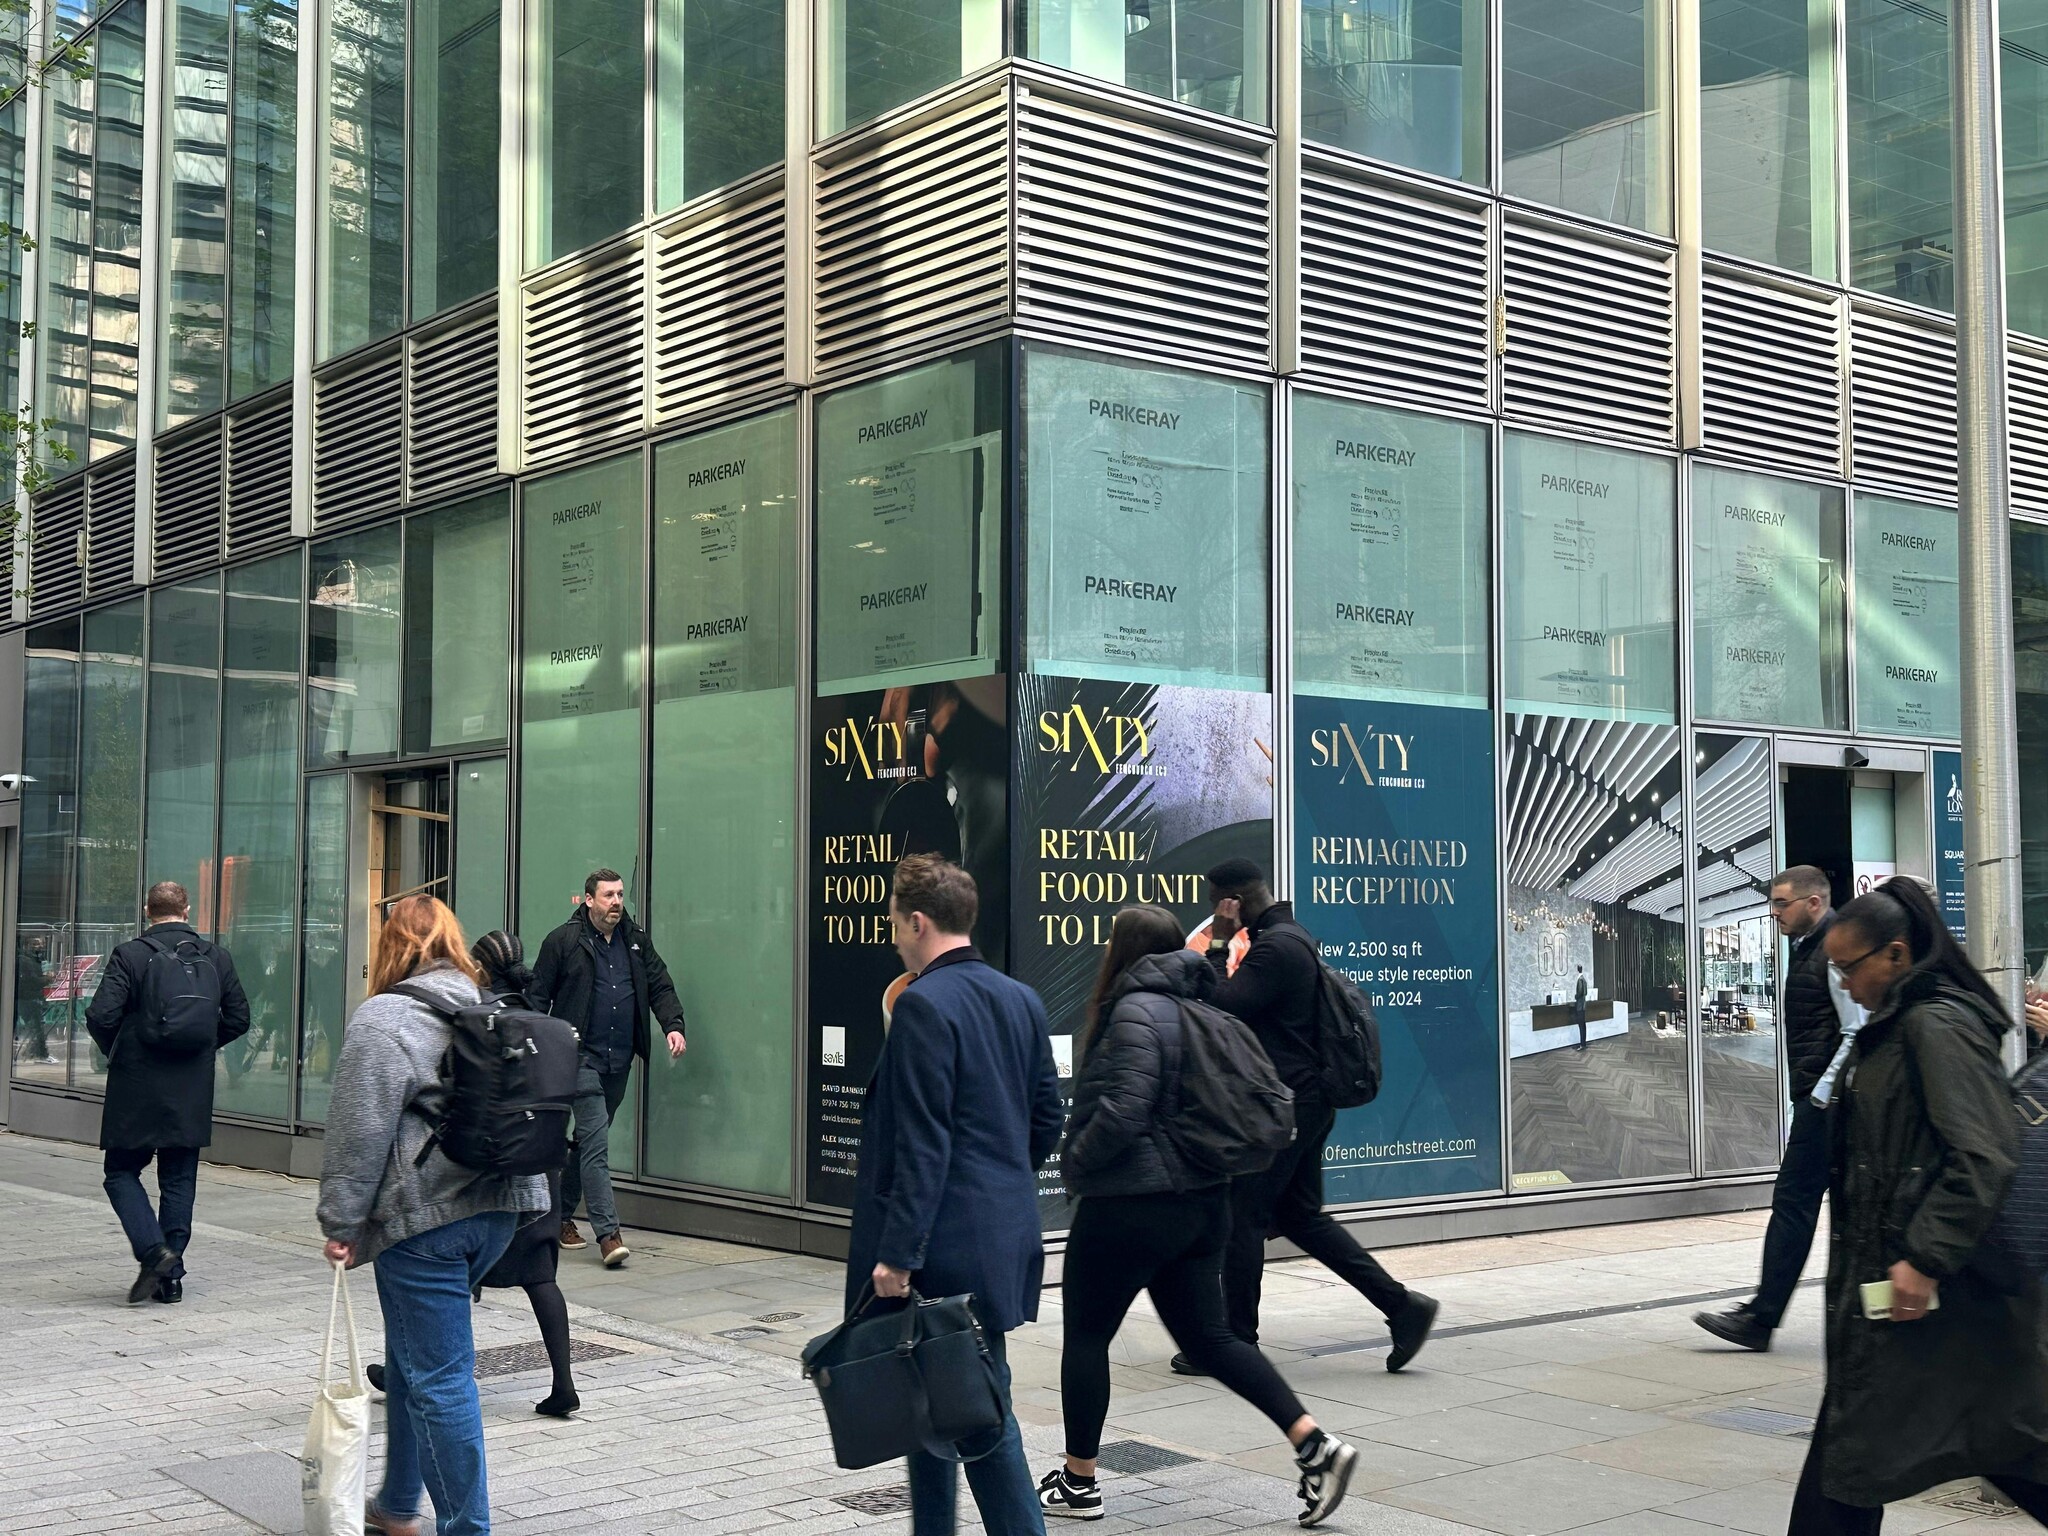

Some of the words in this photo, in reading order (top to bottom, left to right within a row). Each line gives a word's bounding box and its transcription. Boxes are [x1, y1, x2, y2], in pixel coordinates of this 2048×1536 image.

[858, 410, 928, 444] PARKERAY
[1089, 399, 1180, 430] PARKERAY
[1336, 440, 1416, 467] PARKERAY
[688, 459, 746, 488] PARKERAY
[1541, 474, 1609, 499] PARKERAY
[552, 501, 602, 525] PARKERAY
[1724, 505, 1786, 527] PARKERAY
[1882, 532, 1936, 551] PARKERAY
[860, 583, 928, 611] PARKERAY
[1085, 576, 1178, 603] PARKERAY
[687, 616, 749, 640] PARKERAY
[1336, 602, 1415, 627] PARKERAY
[1543, 625, 1607, 647] PARKERAY
[550, 644, 603, 665] PARKERAY
[1726, 646, 1786, 666] PARKERAY
[1886, 666, 1938, 683] PARKERAY
[824, 716, 908, 781] SIXTY
[1039, 704, 1155, 774] SIXTY
[1311, 722, 1414, 786] SIXTY
[1312, 836, 1467, 867] REIMAGINED
[825, 874, 886, 904] FOOD
[1040, 872, 1128, 903] FOOD
[1136, 873, 1206, 904] UNIT
[1312, 875, 1455, 905] RECEPTION
[824, 915, 854, 944] TO
[1039, 914, 1083, 946] TO
[1348, 941, 1387, 959] 2,500
[1392, 944, 1407, 959] sq
[1412, 941, 1422, 956] ft
[1538, 931, 1569, 977] 60
[1378, 965, 1409, 984] style
[1412, 965, 1472, 983] reception
[1372, 991, 1384, 1007] in
[1388, 991, 1422, 1006] 2024
[1321, 1137, 1476, 1161] 0fenchurchstreet.com
